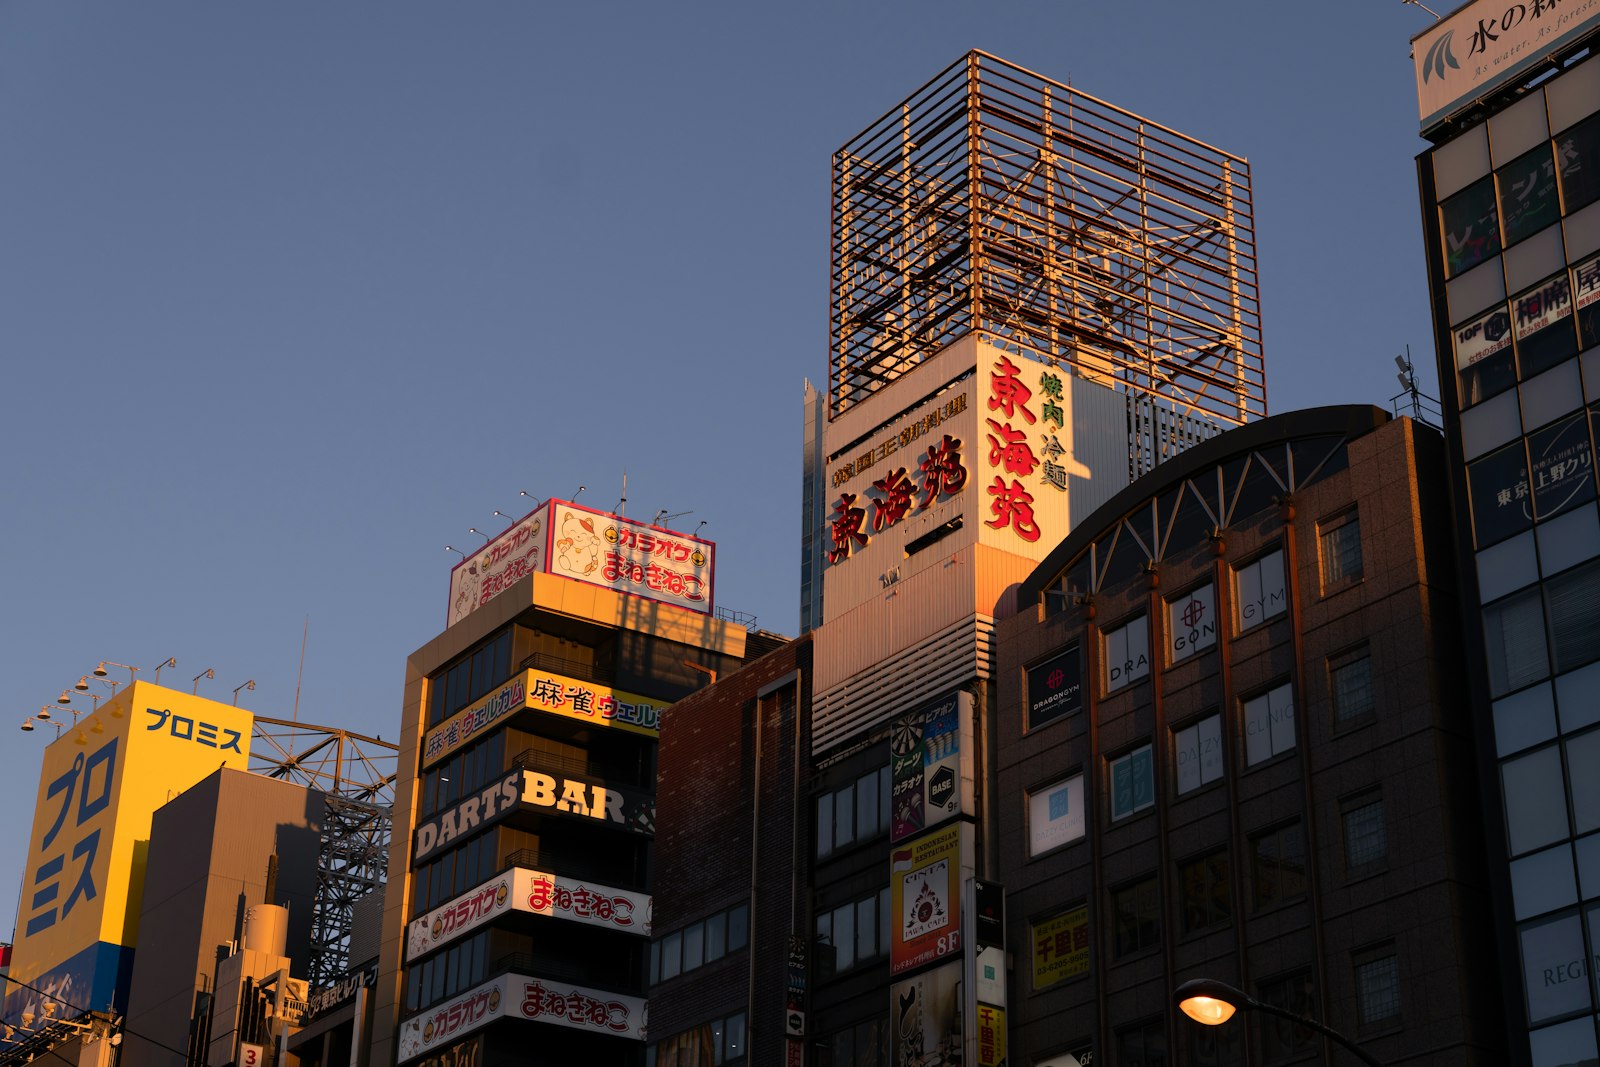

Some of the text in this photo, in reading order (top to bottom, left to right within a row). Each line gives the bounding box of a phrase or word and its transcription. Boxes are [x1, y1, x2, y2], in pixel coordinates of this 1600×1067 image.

[1473, 1, 1597, 80] As water. As forest.
[1458, 322, 1482, 344] 10F
[984, 355, 1041, 542] 東海苑
[828, 434, 968, 565] 東海苑
[1496, 445, 1600, 508] 東京上野クリ
[489, 524, 532, 567] カラオケ
[618, 528, 692, 562] カラオケ
[480, 546, 539, 606] まねきねこ
[601, 550, 706, 602] まねきねこ
[1110, 587, 1285, 682] DRA GON GYM
[530, 677, 661, 731] 麻雀ウェル
[1033, 683, 1080, 711] DRAGONGYM
[1246, 704, 1295, 736] CLINIC
[146, 707, 242, 755] プロミス
[893, 773, 924, 797] カラオケ
[894, 751, 922, 776] ダーツ
[932, 778, 952, 796] BASE
[42, 736, 119, 852] プロ
[416, 769, 626, 860] DARTS BAR
[948, 801, 958, 813] 9F
[914, 839, 959, 864] RESTAURANT
[916, 829, 957, 853] INDONESIAN
[26, 827, 101, 938] ミス
[905, 862, 946, 884] CINTA
[442, 885, 498, 935] カラオケ
[527, 875, 635, 927] まねきねこ
[937, 930, 960, 956] 8F
[433, 991, 490, 1038] カラオケ
[520, 980, 631, 1032] まねきねこ
[246, 1049, 256, 1065] 3
[1080, 1051, 1093, 1067] 6F
